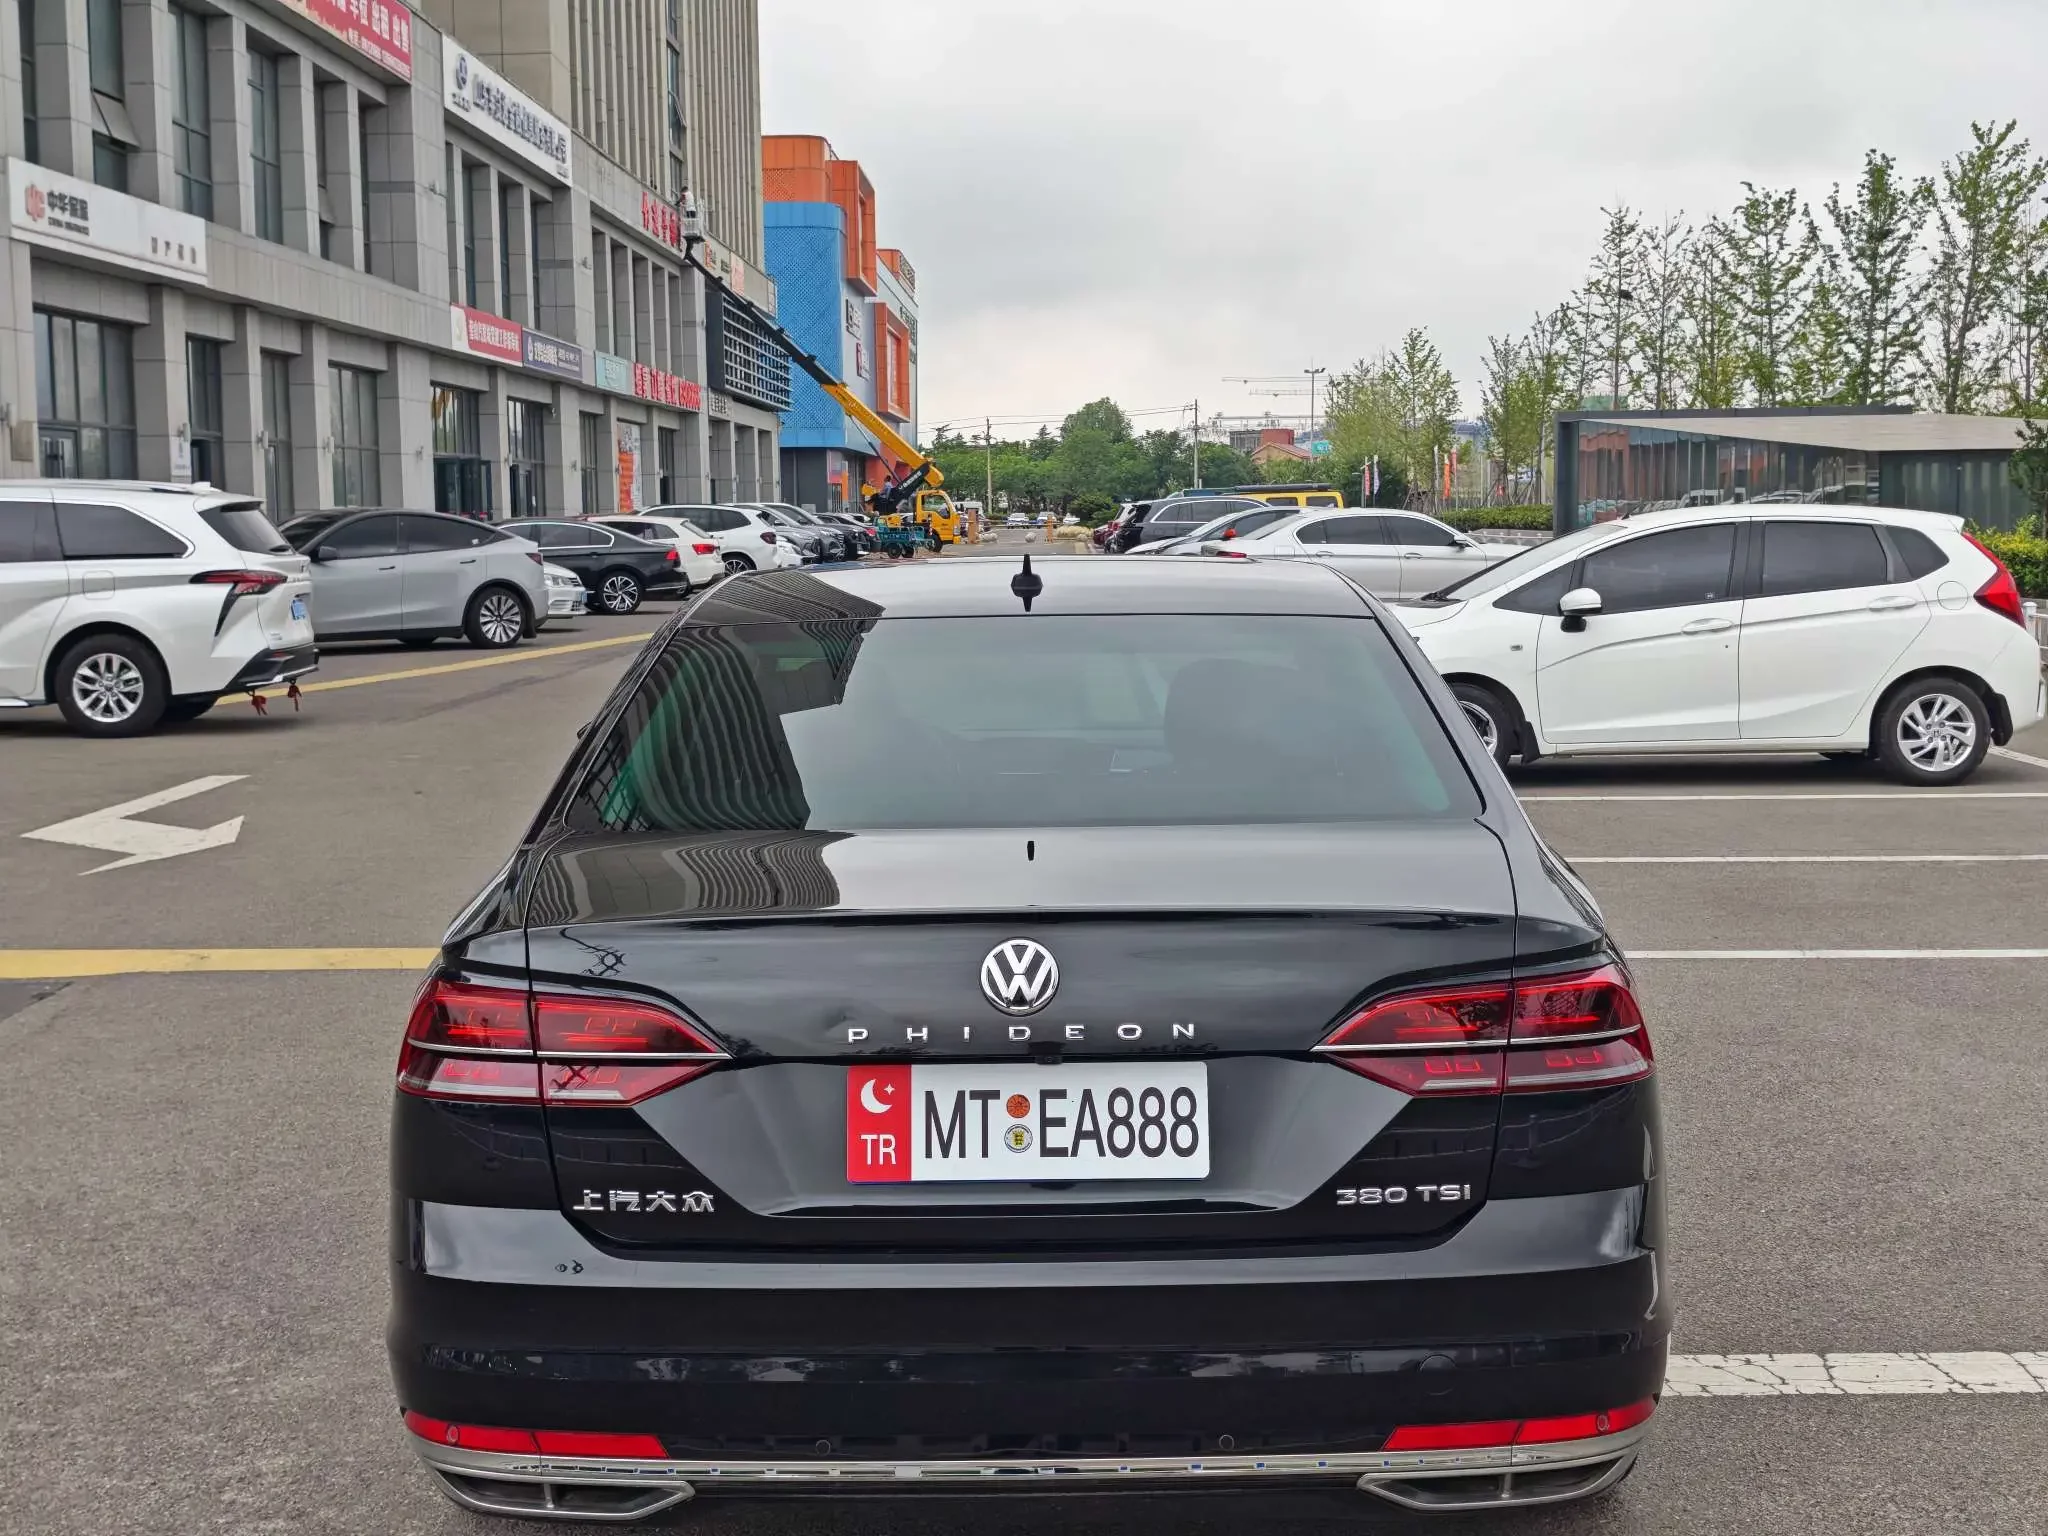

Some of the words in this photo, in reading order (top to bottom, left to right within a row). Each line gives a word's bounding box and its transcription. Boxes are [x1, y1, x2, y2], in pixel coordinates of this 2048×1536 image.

[847, 1022, 1197, 1045] PHIDEON
[924, 1089, 1001, 1160] MT
[1039, 1086, 1199, 1159] EA888
[860, 1133, 897, 1166] TR
[572, 1189, 715, 1213] 上汽大众
[1336, 1187, 1408, 1206] 380
[1415, 1184, 1472, 1203] TSI
